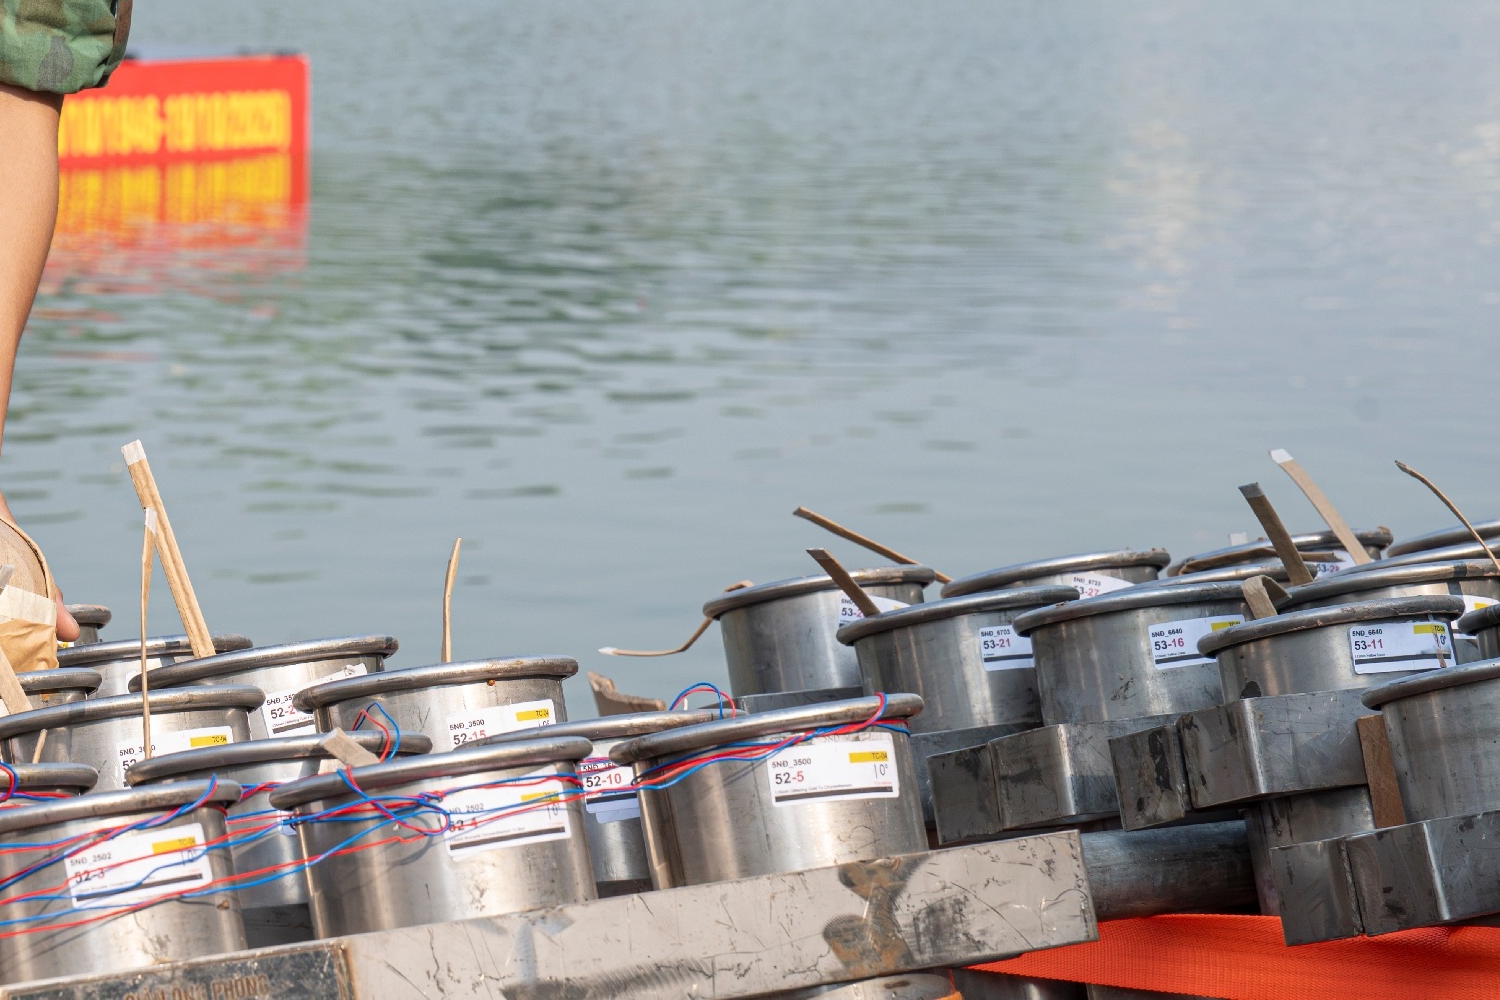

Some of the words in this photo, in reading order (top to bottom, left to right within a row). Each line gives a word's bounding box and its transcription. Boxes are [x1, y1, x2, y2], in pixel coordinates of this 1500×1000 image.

[1074, 586, 1100, 597] 3-27
[983, 638, 1011, 649] 53-21
[1154, 637, 1185, 651] 53-16
[1354, 638, 1384, 651] 53-11
[453, 729, 487, 745] 52-15
[871, 751, 888, 760] TC-04
[586, 772, 622, 788] 52-10
[775, 771, 805, 785] 52-5
